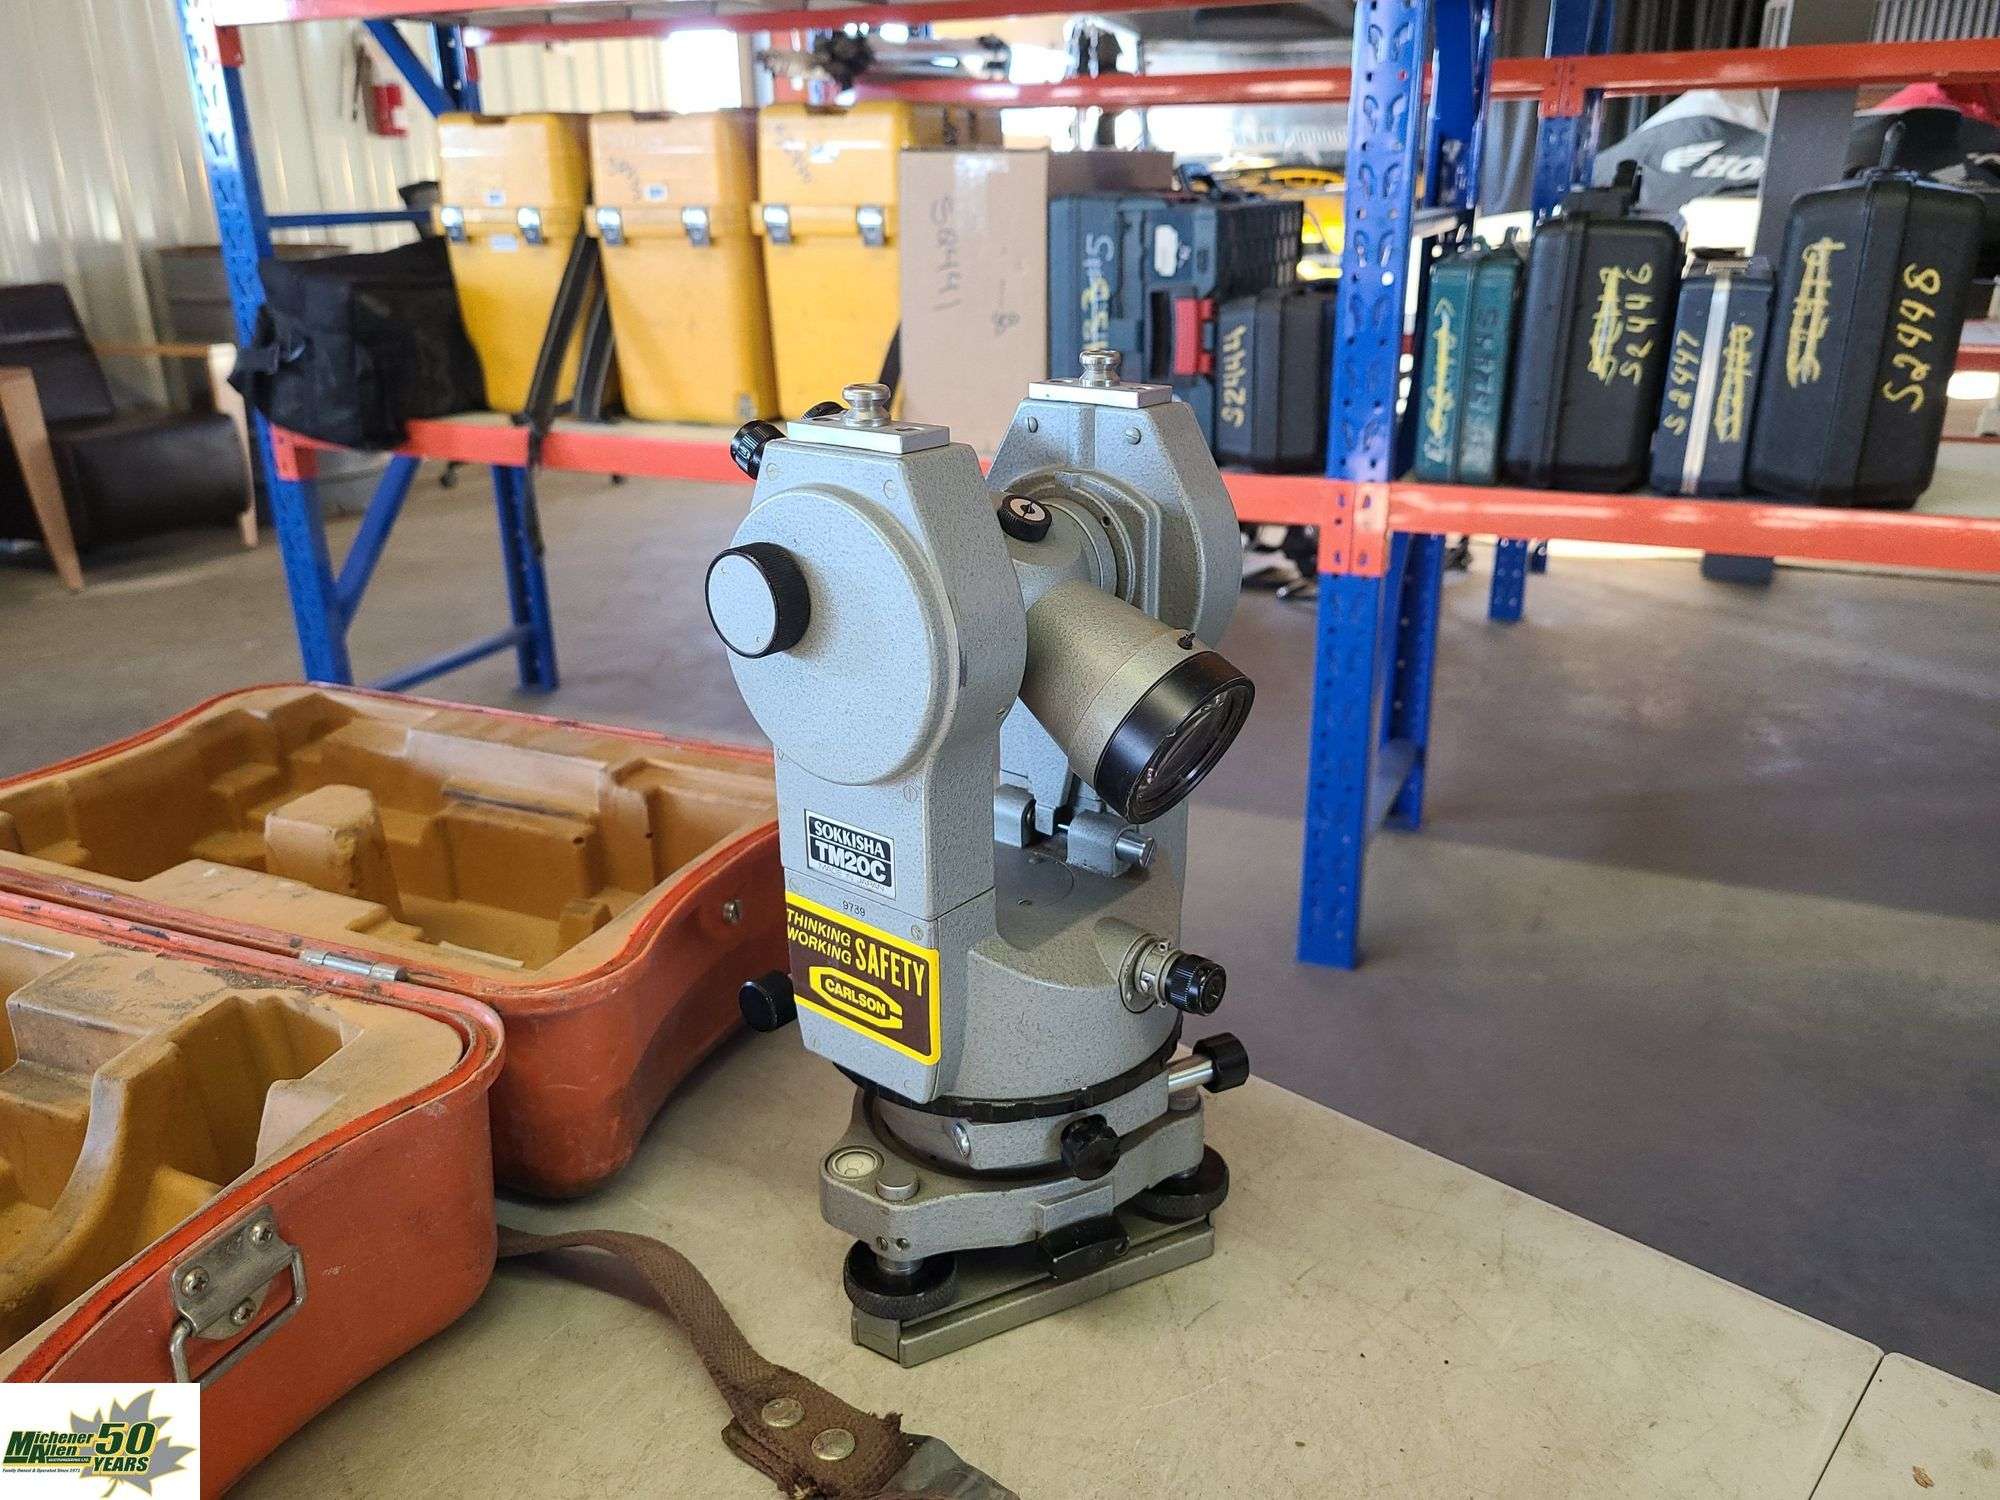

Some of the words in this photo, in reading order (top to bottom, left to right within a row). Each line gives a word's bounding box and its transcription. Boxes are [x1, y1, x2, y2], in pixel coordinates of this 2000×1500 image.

[1618, 262, 1658, 386] S2446
[1882, 262, 1942, 413] S2448
[1220, 324, 1248, 429] S2444
[1663, 328, 1700, 436] S2447
[814, 820, 885, 859] SOKKISHA
[815, 840, 886, 882] TM20C
[787, 908, 851, 948] THINKING
[842, 900, 866, 917] 9739
[787, 925, 852, 965] WORKING
[855, 937, 926, 997] SAFETY
[825, 978, 886, 1017] CARLSON
